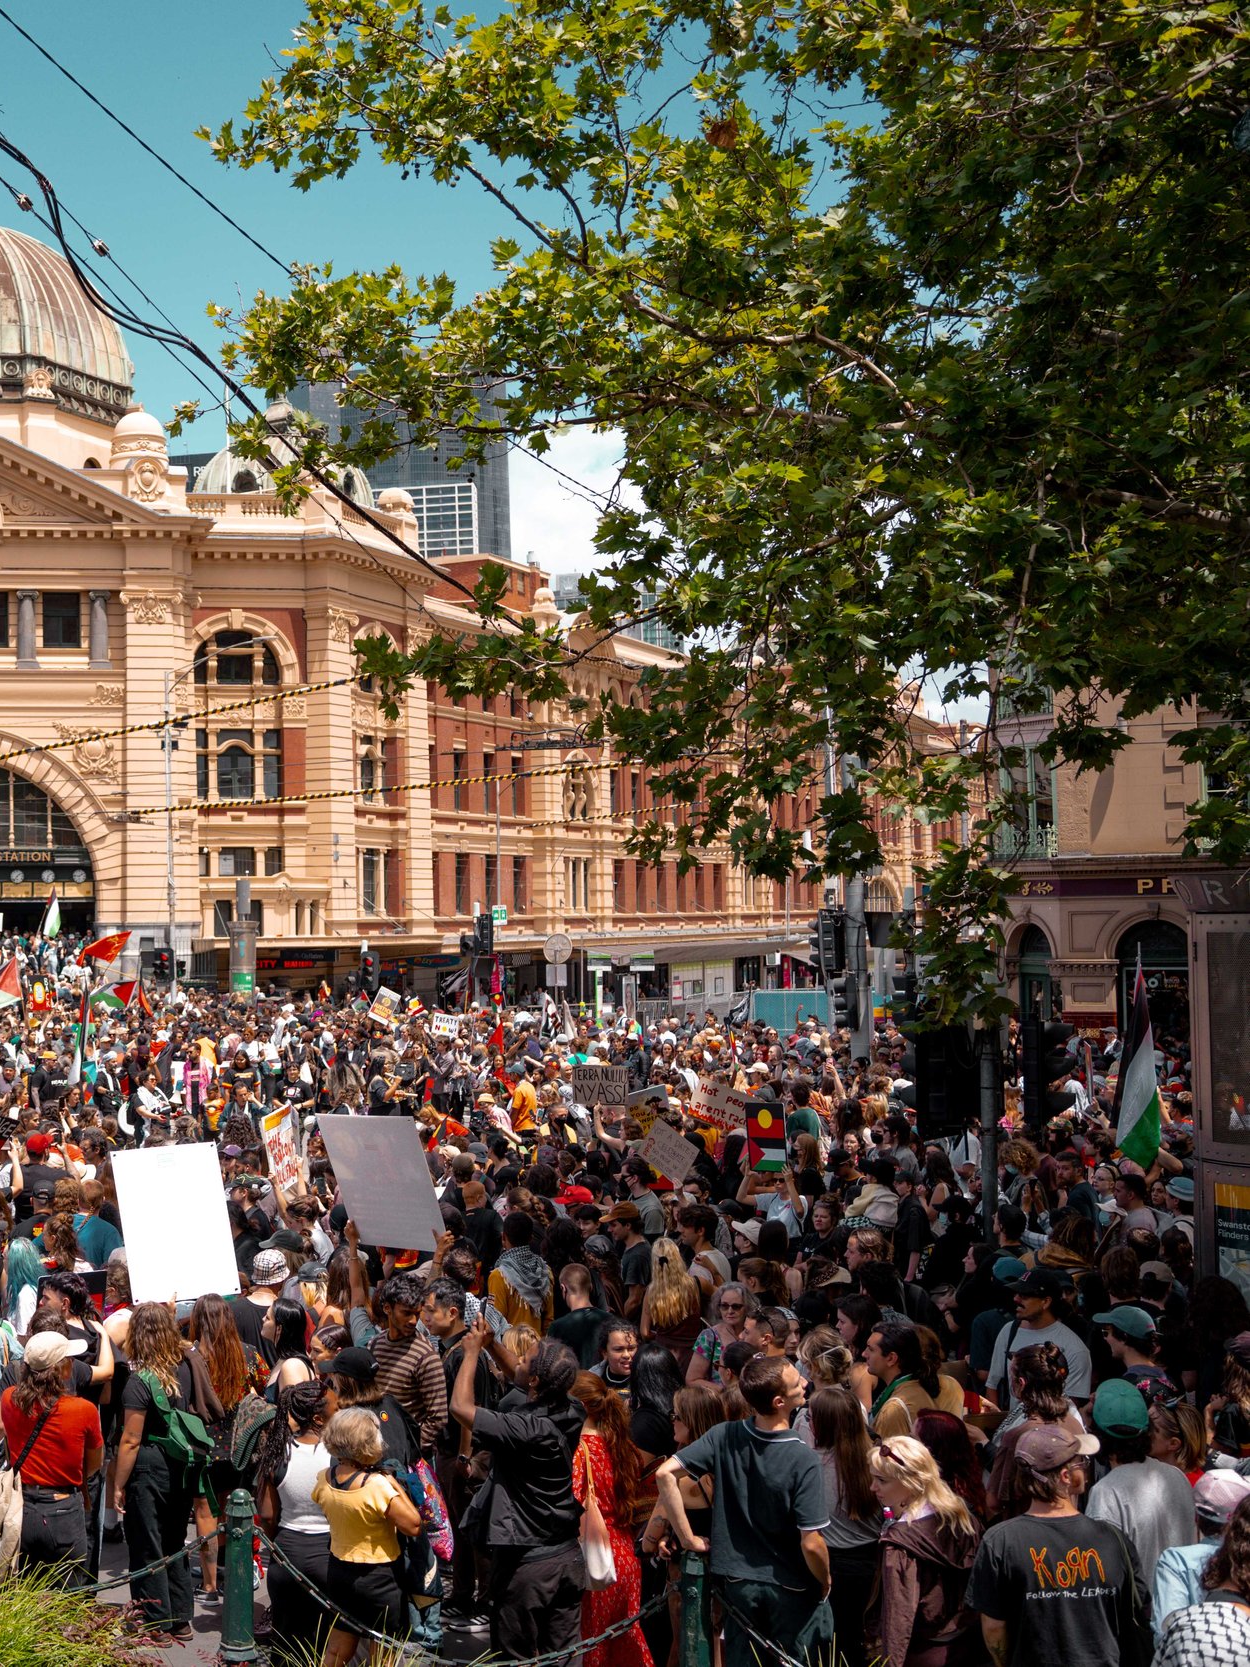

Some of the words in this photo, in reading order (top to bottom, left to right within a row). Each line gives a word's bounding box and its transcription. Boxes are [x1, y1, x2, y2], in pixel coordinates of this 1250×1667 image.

[434, 1015, 458, 1027] TREATY
[574, 1066, 599, 1081] TERRA
[701, 1083, 719, 1097] Hot
[268, 1131, 281, 1154] THE
[1218, 1228, 1250, 1241] Flinders
[1062, 1590, 1079, 1599] the
